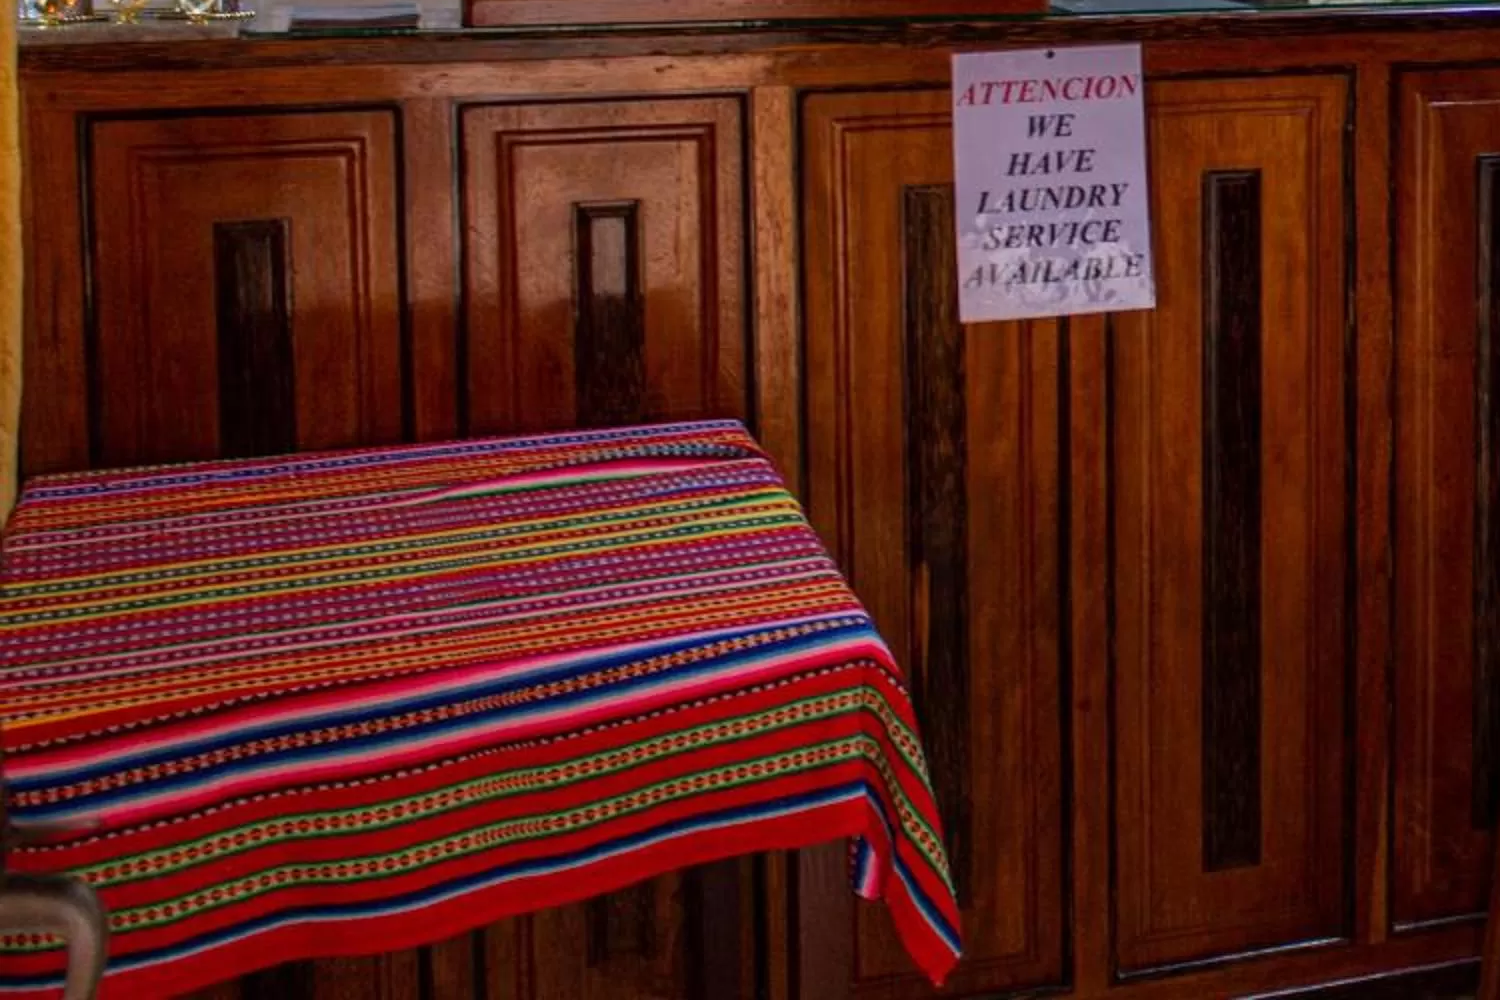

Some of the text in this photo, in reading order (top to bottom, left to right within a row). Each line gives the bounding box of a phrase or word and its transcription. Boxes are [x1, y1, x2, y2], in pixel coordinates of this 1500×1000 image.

[957, 73, 1139, 106] ATTENCION
[1026, 113, 1075, 138] WE
[1007, 149, 1096, 177] HAVE
[976, 183, 1129, 214] LAUNDRY
[983, 219, 1122, 250] SERVICE
[963, 253, 1145, 289] AVAILABLE
